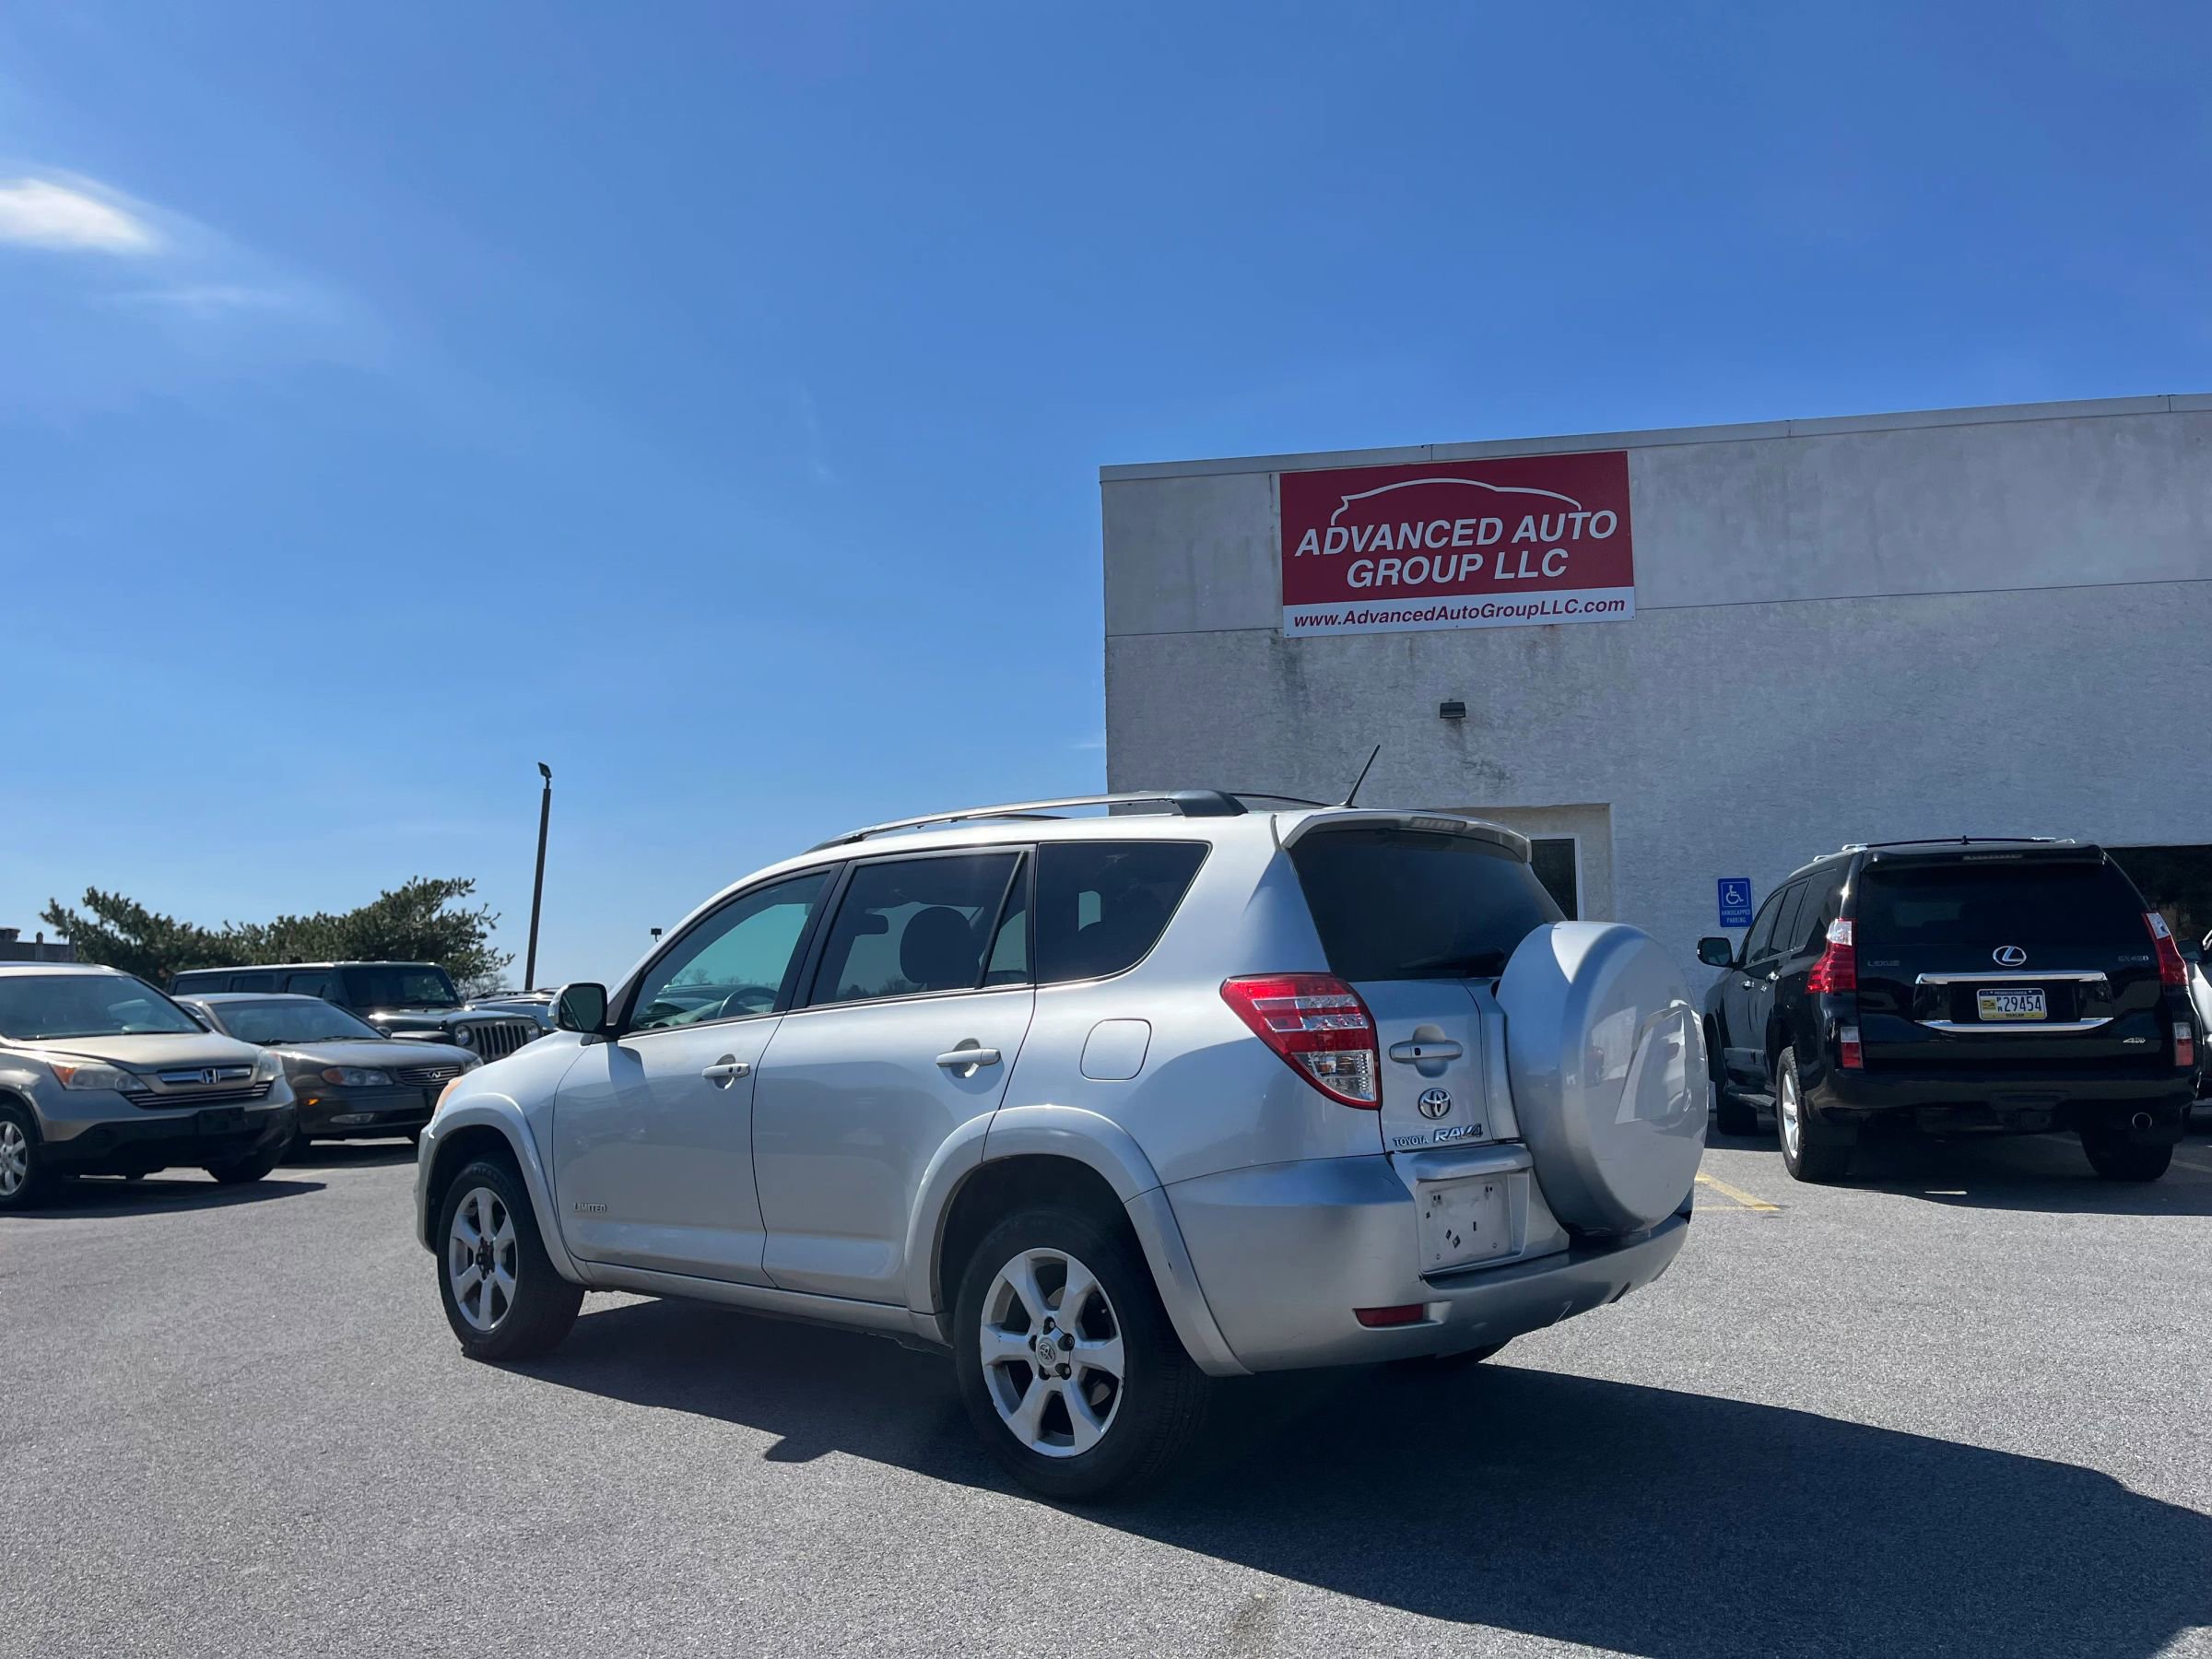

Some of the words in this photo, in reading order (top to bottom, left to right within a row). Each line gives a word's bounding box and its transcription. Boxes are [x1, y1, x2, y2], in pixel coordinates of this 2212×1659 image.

[1295, 517, 1503, 556] ADVANCED
[1512, 510, 1618, 544] AUTO
[1347, 554, 1482, 588] GROUP
[1494, 548, 1569, 580] LLC
[1294, 599, 1626, 627] www.AdvancedAutoGroupLLC.com
[1393, 1135, 1429, 1147] TOYOTA
[1433, 1124, 1483, 1143] RAV4
[573, 1202, 608, 1213] LIMITED
